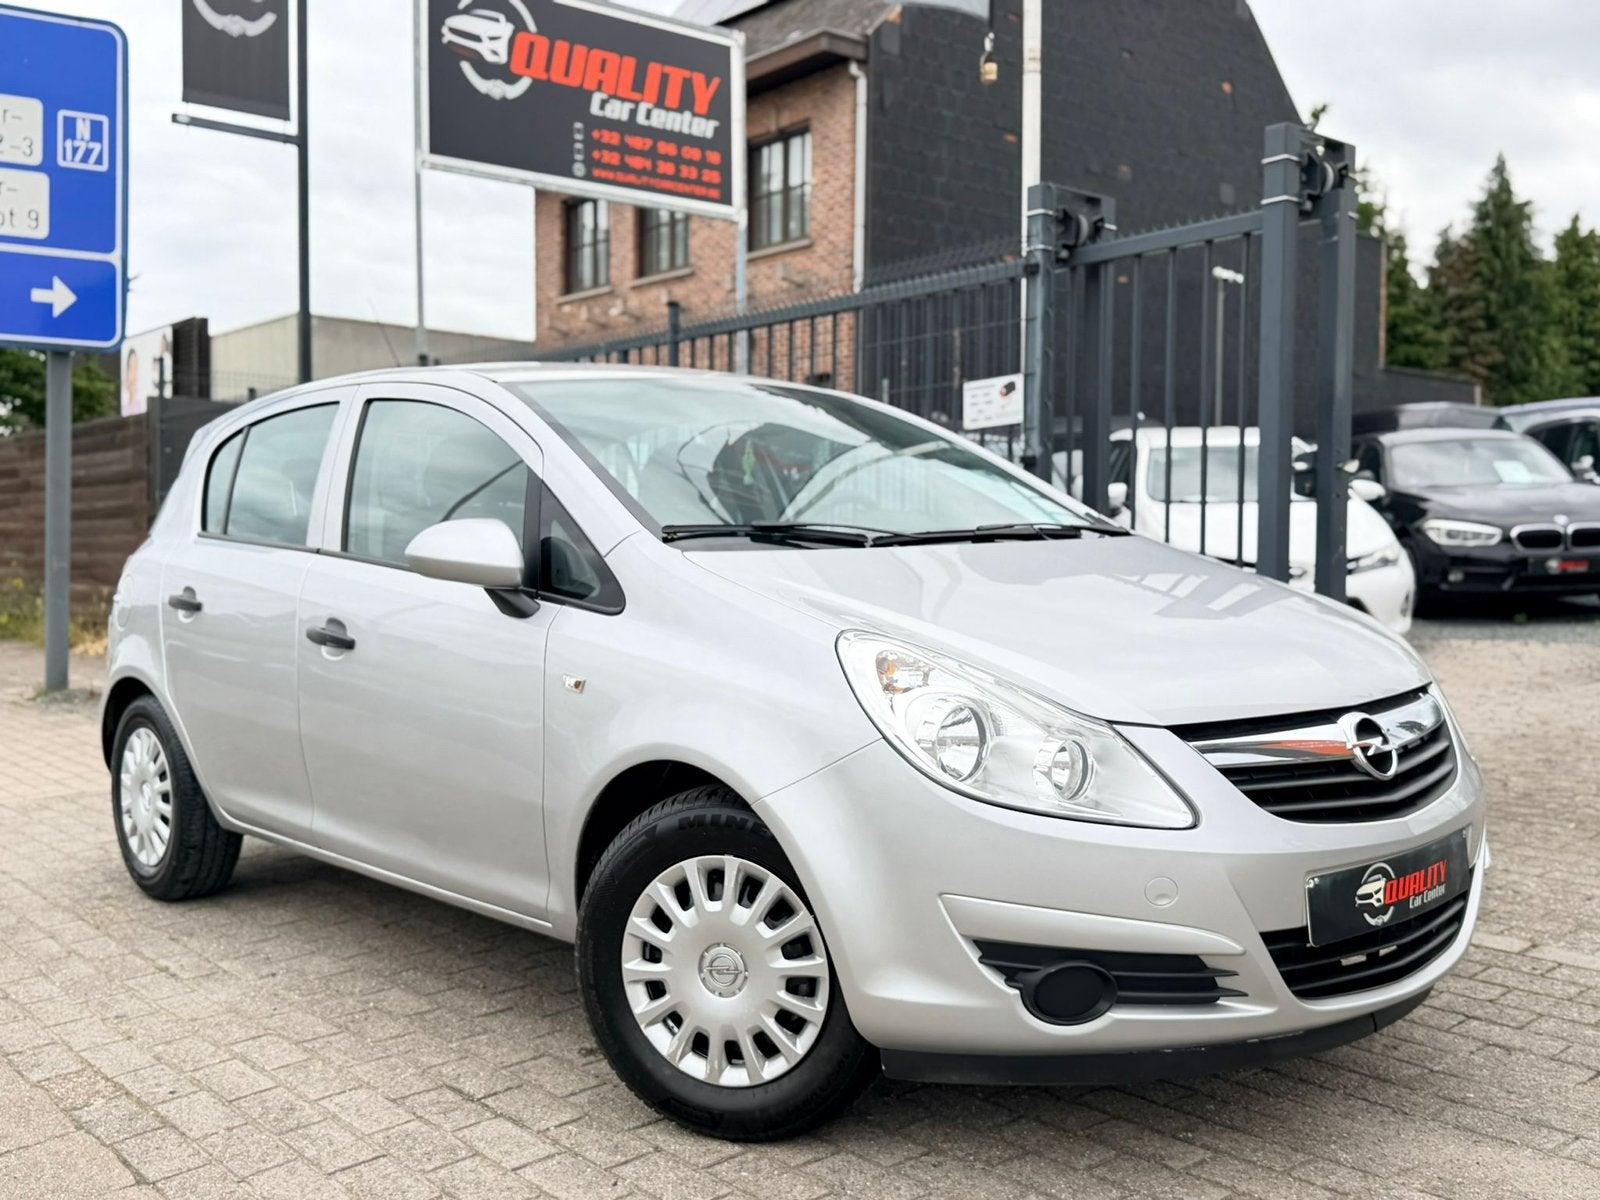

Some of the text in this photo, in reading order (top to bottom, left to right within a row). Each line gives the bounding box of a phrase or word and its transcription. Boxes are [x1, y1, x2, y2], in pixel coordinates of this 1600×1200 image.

[509, 31, 722, 116] QUALITY
[589, 91, 720, 139] Car Center
[75, 117, 91, 141] N
[64, 138, 102, 165] 177
[28, 209, 39, 230] 9
[1385, 859, 1447, 905] QUALITY
[1409, 884, 1446, 909] Car Center
